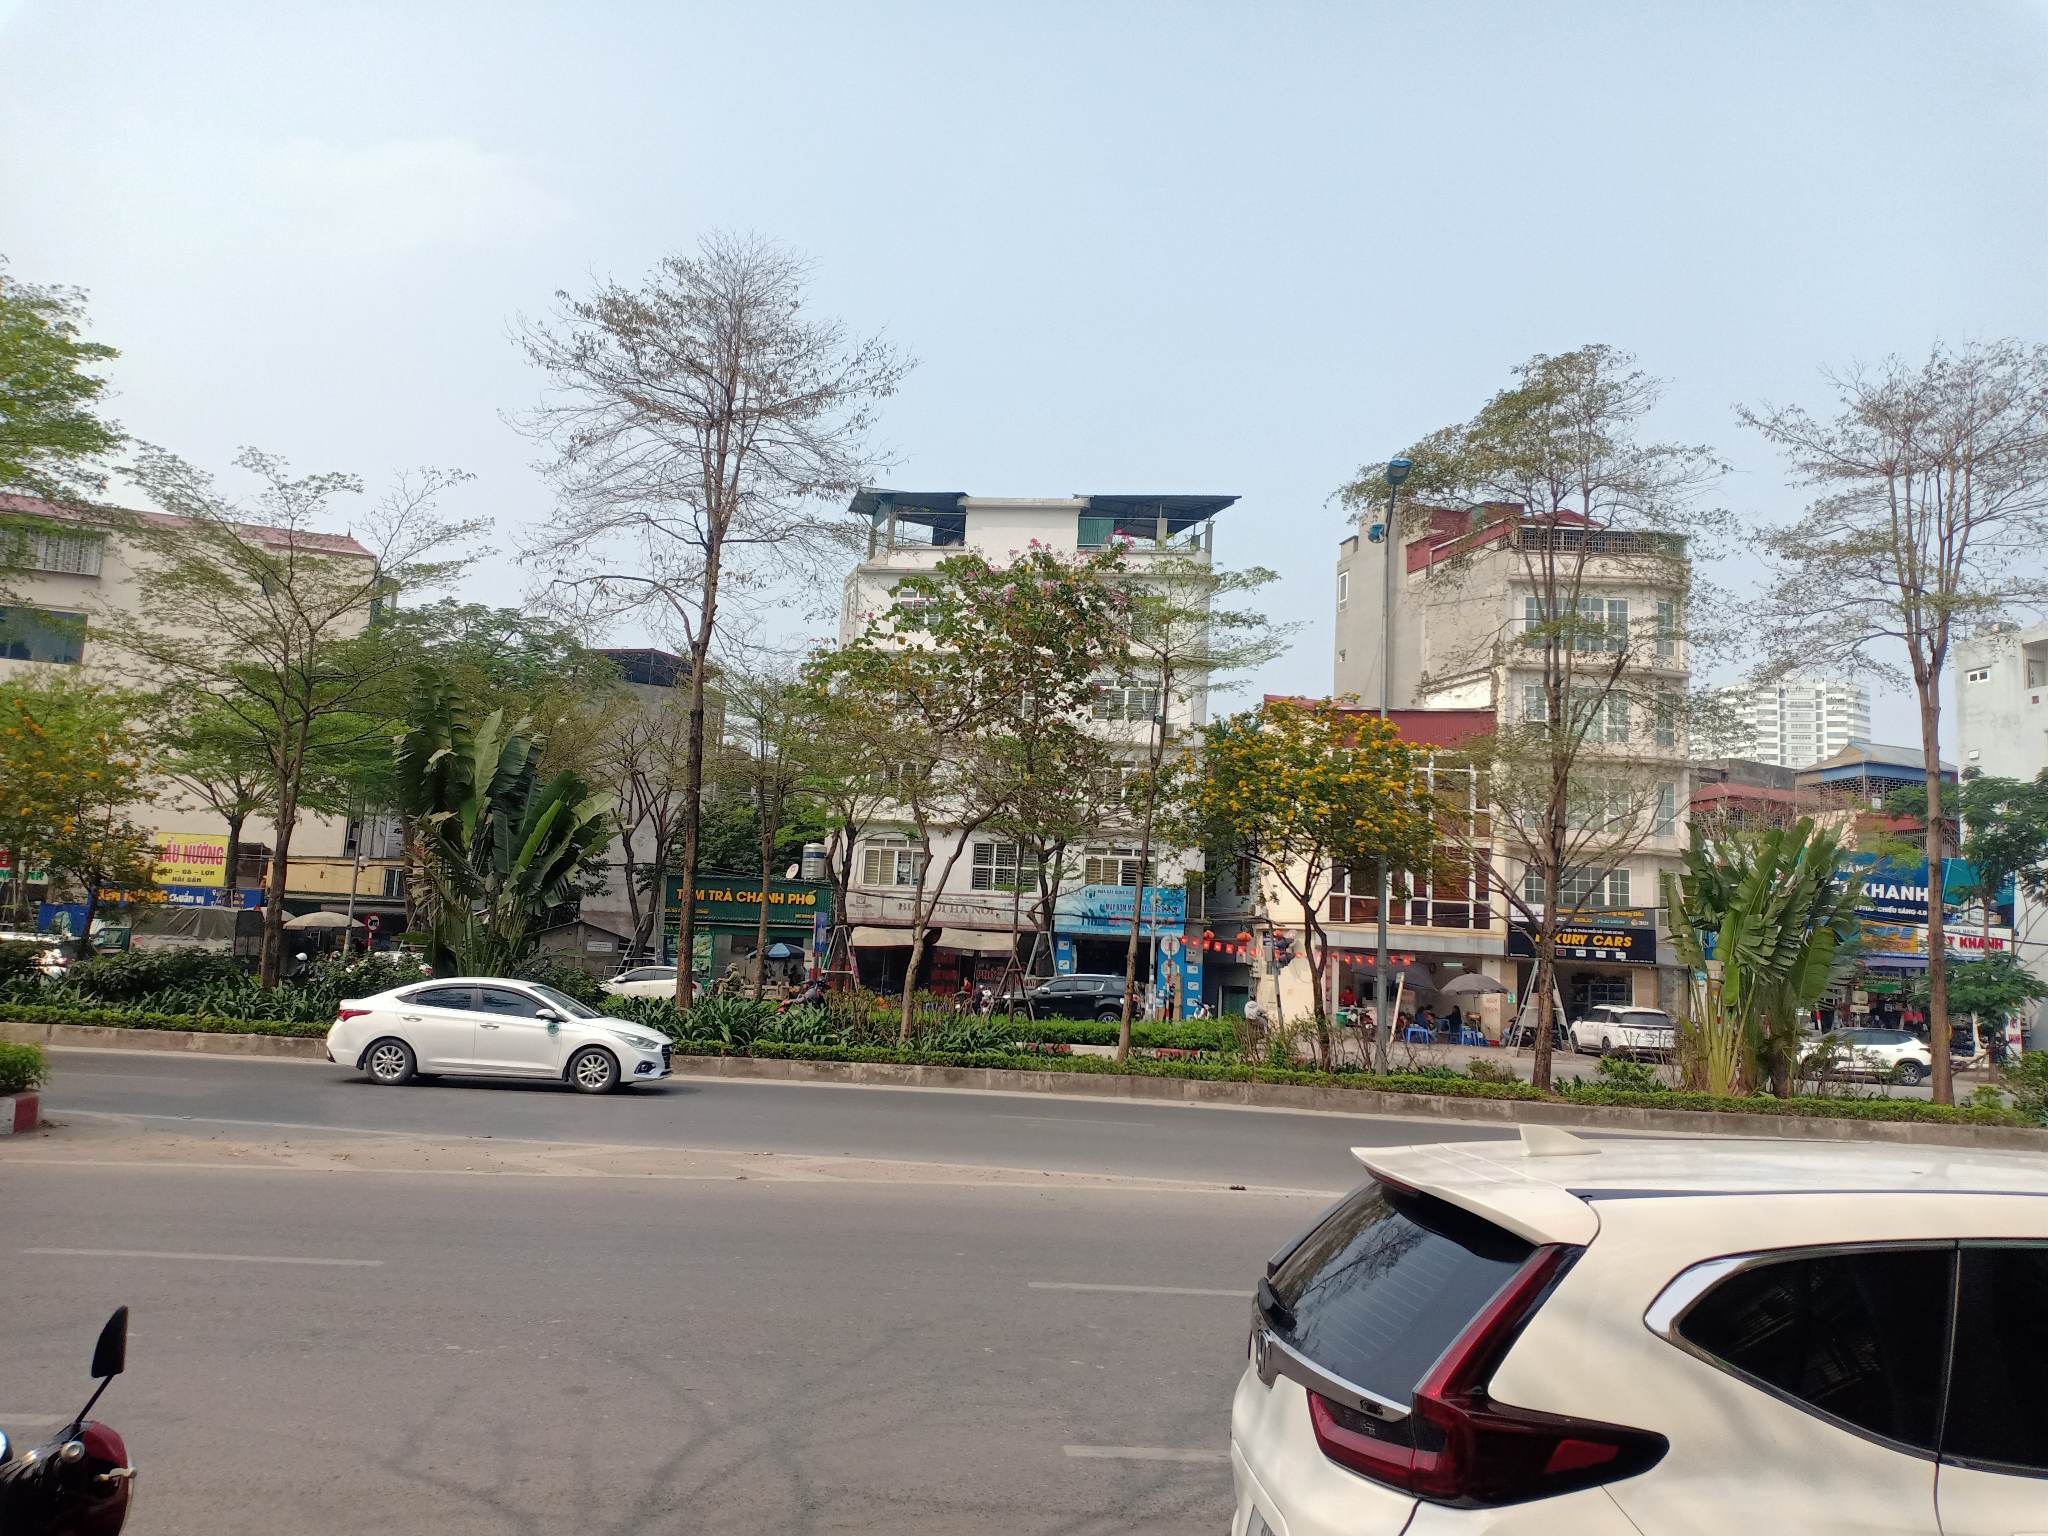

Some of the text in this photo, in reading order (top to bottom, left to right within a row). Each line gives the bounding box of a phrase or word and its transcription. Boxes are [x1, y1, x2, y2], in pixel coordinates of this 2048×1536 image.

[708, 887, 733, 902] TRÀ
[736, 890, 784, 904] CHANH
[787, 889, 817, 905] PHỐ
[1592, 934, 1633, 947] CARS
